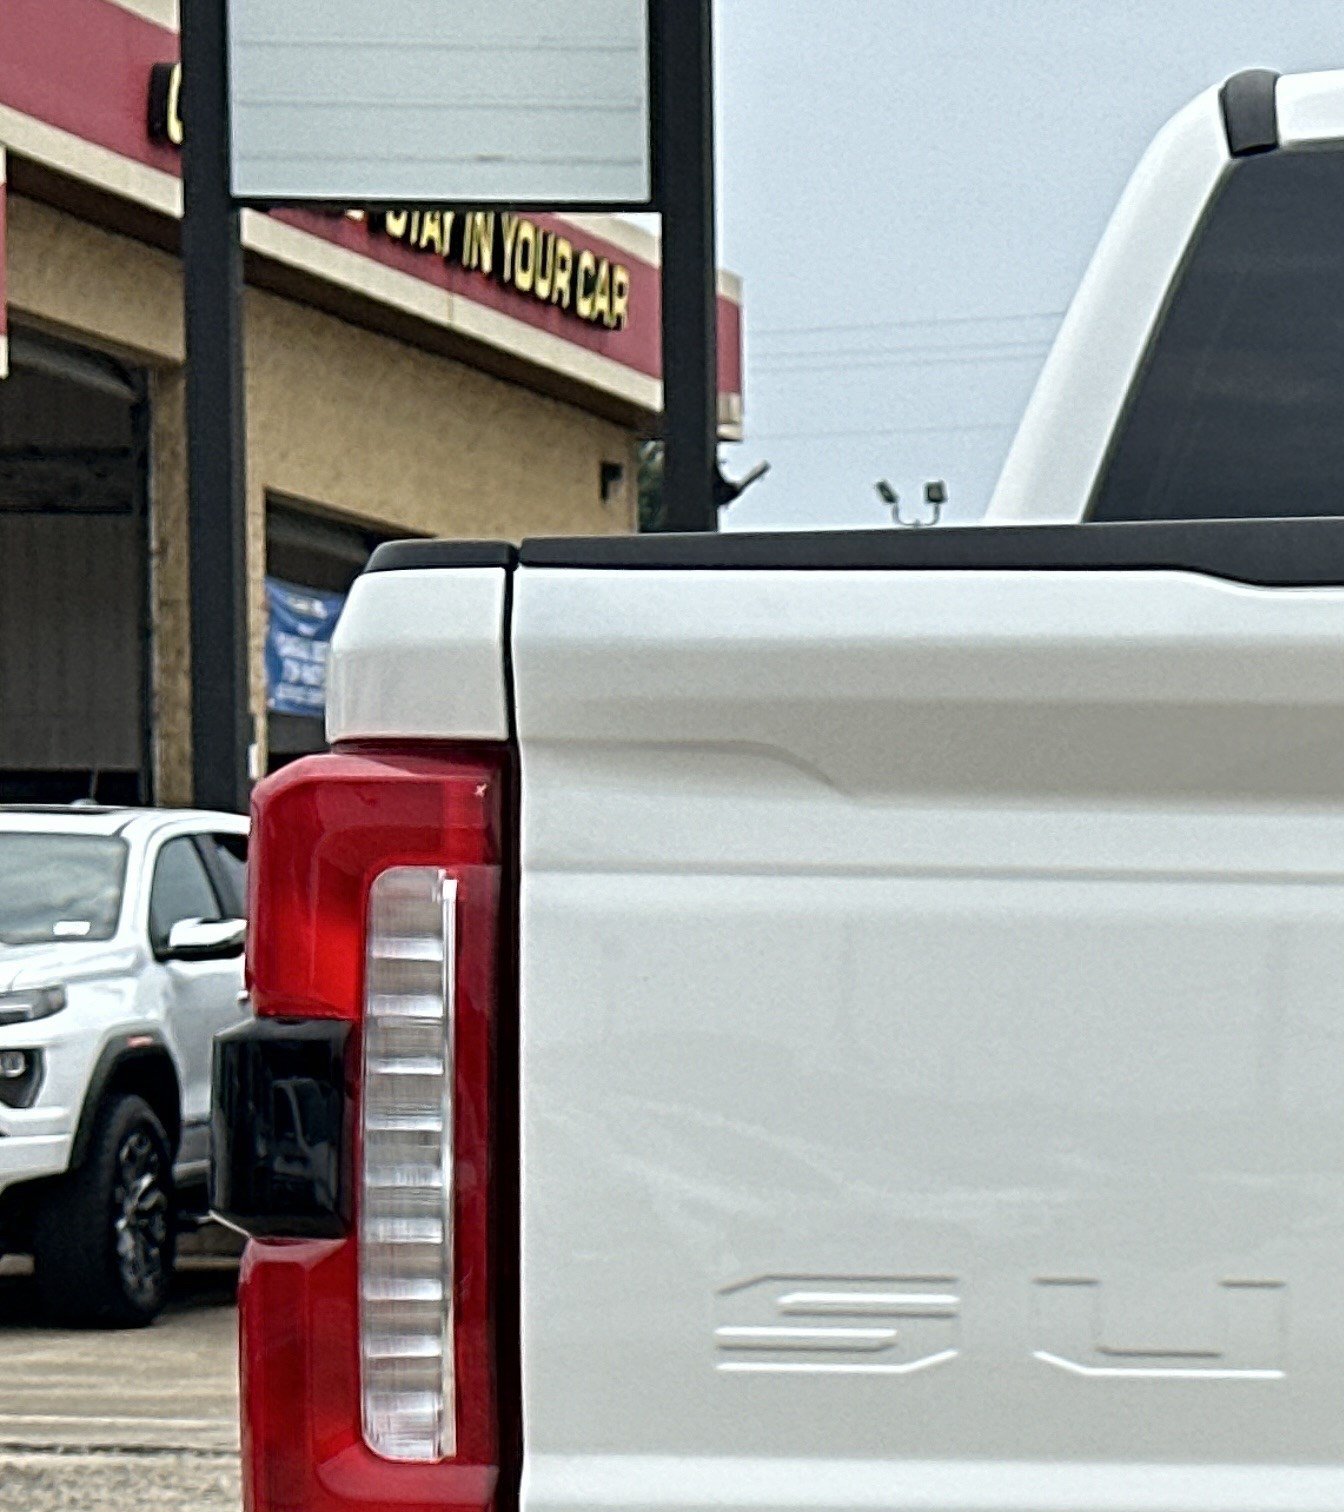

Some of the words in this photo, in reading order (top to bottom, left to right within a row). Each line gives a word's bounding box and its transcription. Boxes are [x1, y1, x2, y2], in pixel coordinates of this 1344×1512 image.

[462, 210, 495, 275] IN
[501, 211, 573, 309] YOUR
[576, 249, 631, 331] CAR
